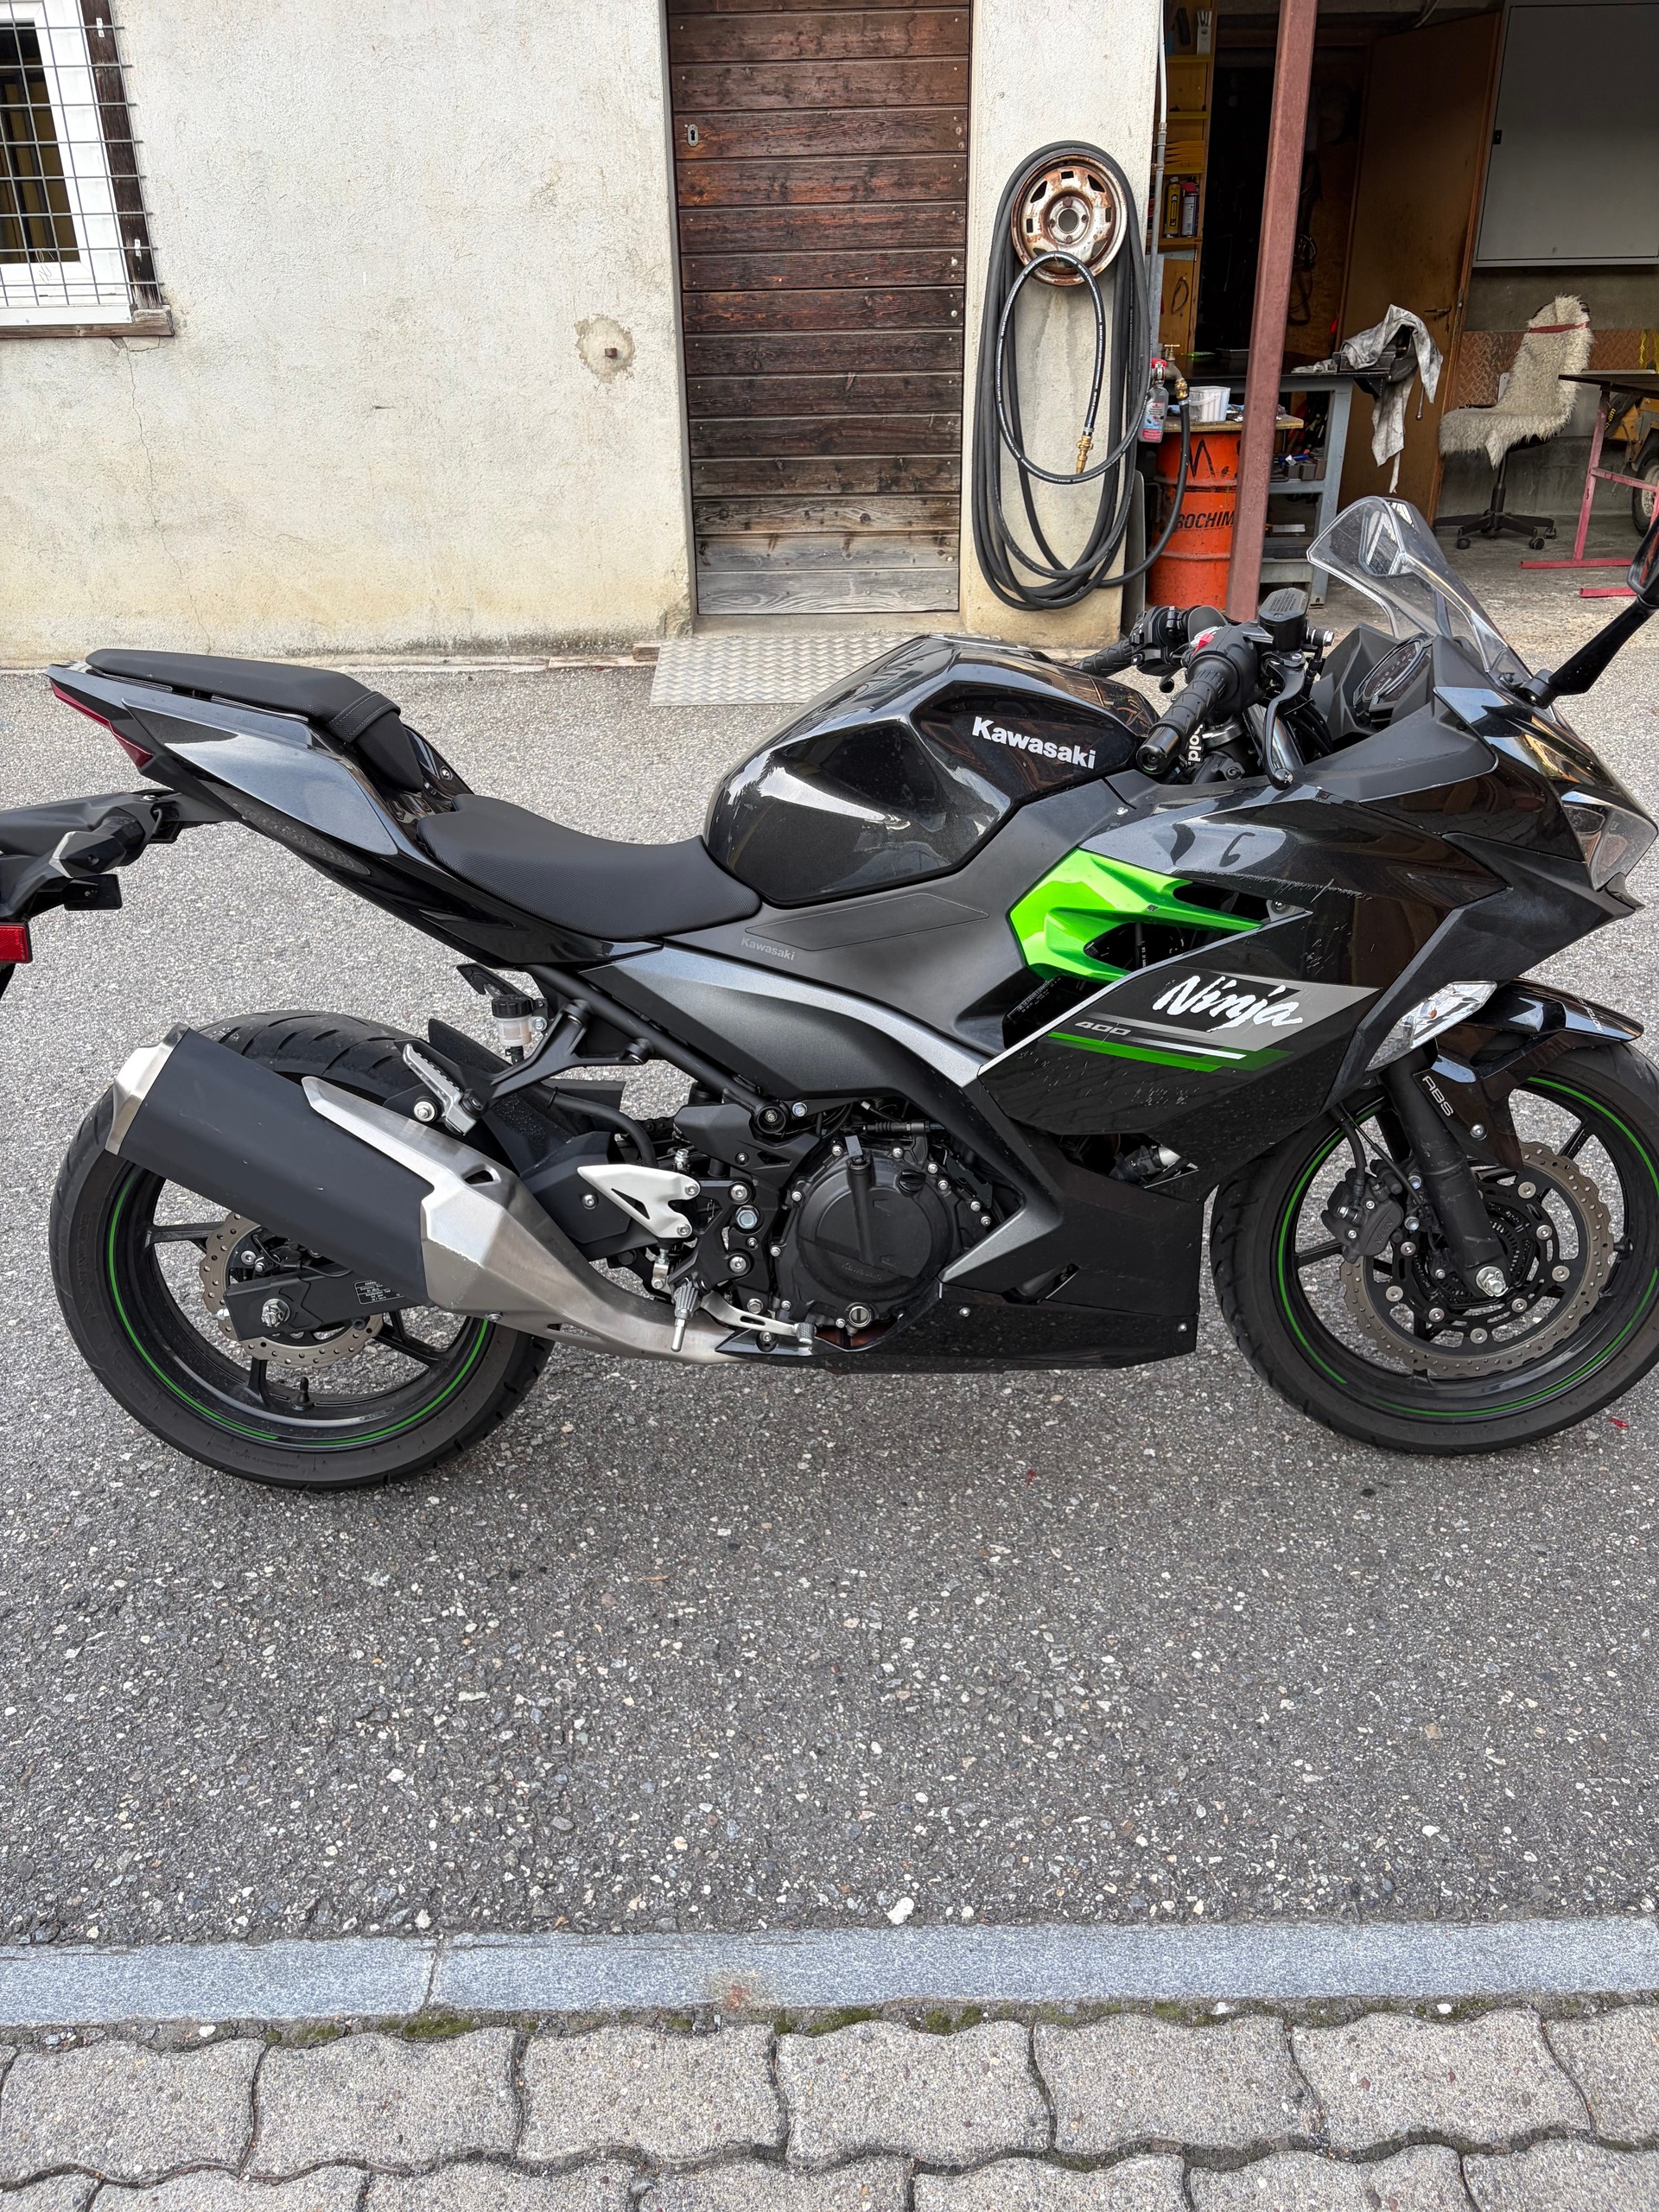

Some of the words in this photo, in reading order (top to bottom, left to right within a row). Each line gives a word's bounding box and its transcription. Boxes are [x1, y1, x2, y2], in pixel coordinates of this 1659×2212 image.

[971, 716, 1097, 770] Kawasaki
[741, 937, 796, 961] Kawasaki
[1152, 975, 1304, 1033] Ninja
[1074, 1020, 1132, 1037] 400
[1421, 1075, 1454, 1117] ABS
